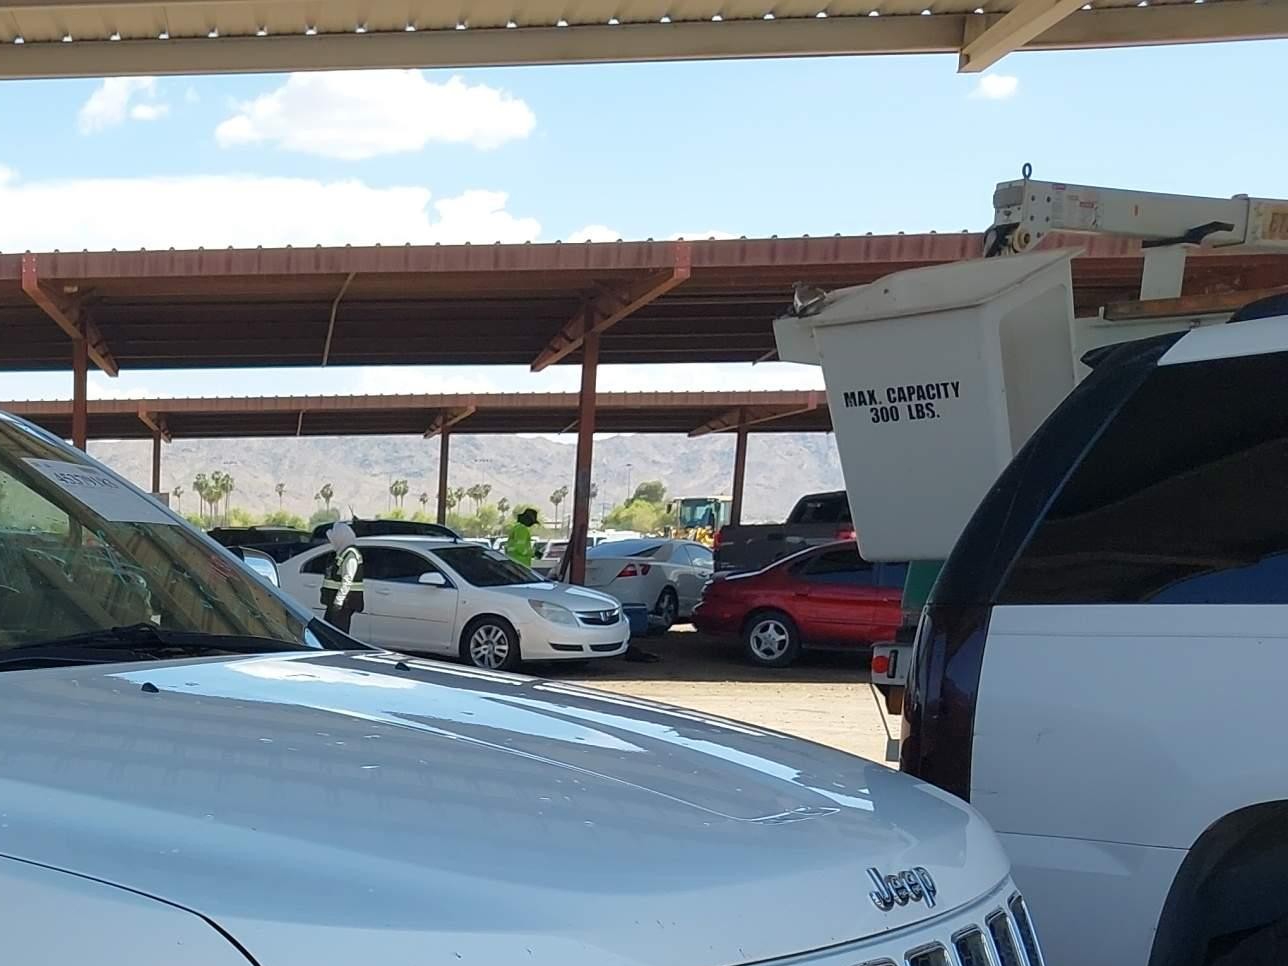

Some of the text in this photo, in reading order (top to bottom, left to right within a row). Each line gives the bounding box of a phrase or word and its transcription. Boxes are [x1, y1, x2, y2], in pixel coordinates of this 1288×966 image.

[843, 381, 961, 409] MAX. CAPACITY
[870, 402, 941, 424] 300 LBS.
[865, 866, 937, 912] Jeep
